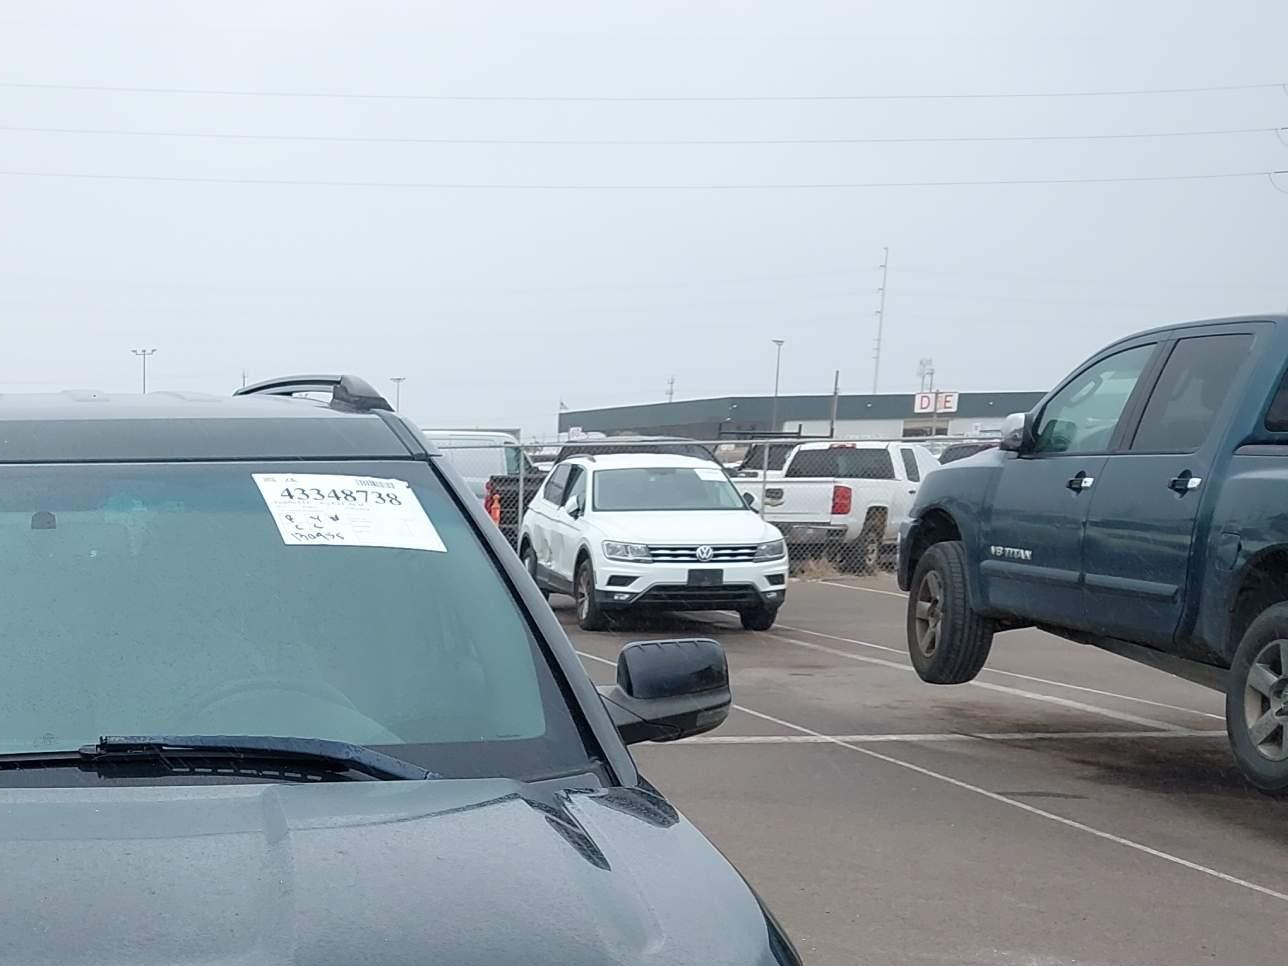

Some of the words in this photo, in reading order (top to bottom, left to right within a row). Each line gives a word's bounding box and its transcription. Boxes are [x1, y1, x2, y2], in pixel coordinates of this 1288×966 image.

[920, 395, 930, 409] D
[944, 395, 953, 409] E
[280, 487, 402, 506] 43348738
[1004, 547, 1032, 560] TITAN
